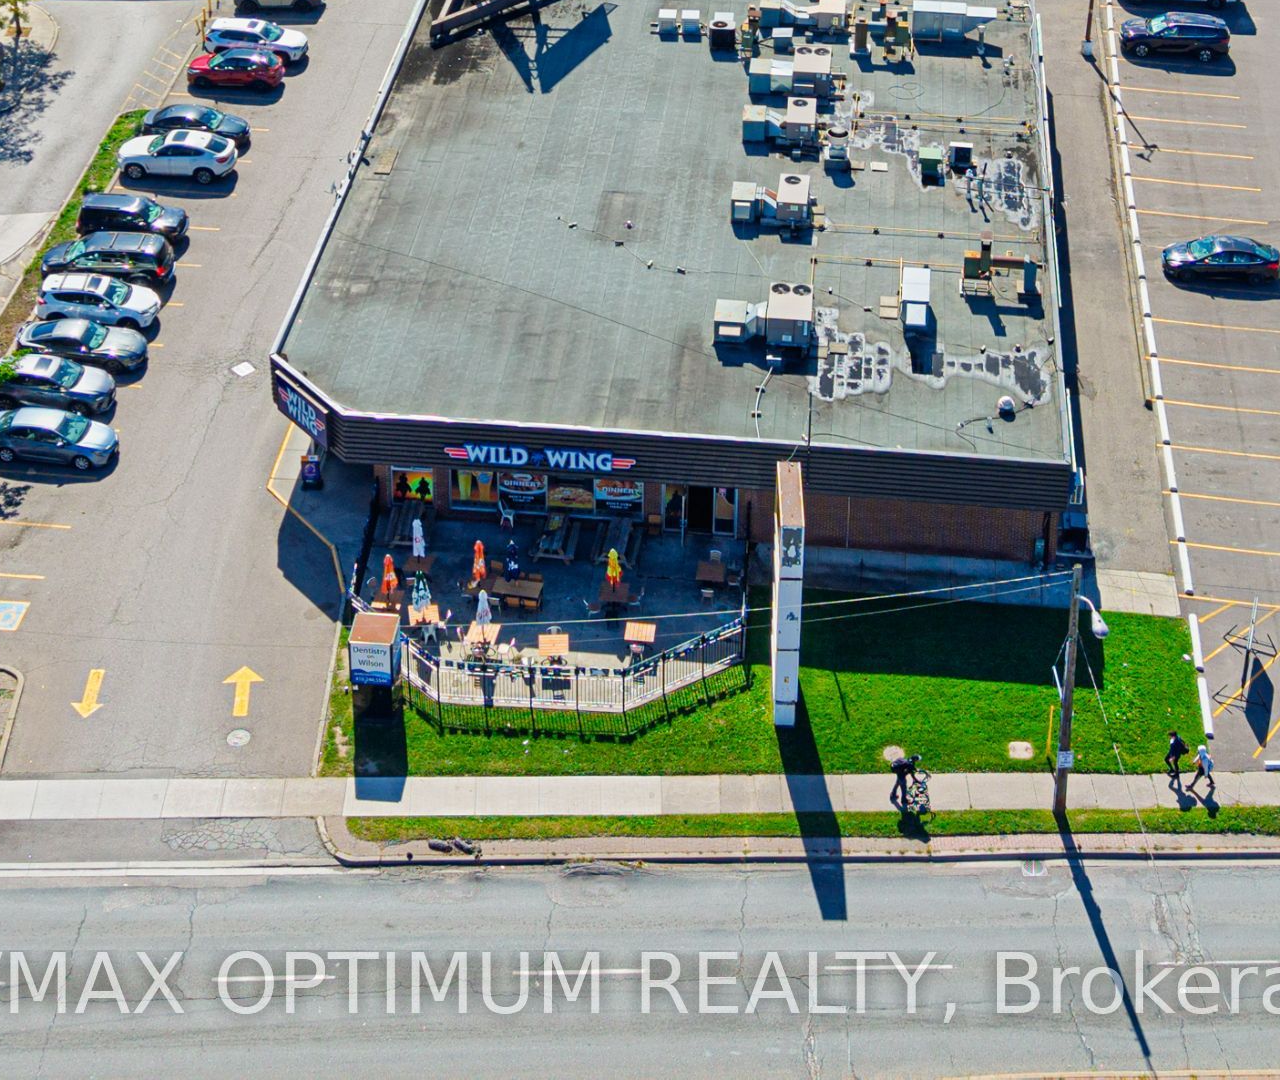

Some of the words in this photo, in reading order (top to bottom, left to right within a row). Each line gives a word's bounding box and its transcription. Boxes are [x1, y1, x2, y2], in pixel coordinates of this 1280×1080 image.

[286, 387, 317, 420] WILD
[286, 400, 318, 436] WING
[464, 444, 528, 465] WILD
[544, 449, 613, 471] WING
[352, 646, 388, 656] Dentistry
[358, 659, 384, 668] Wilson
